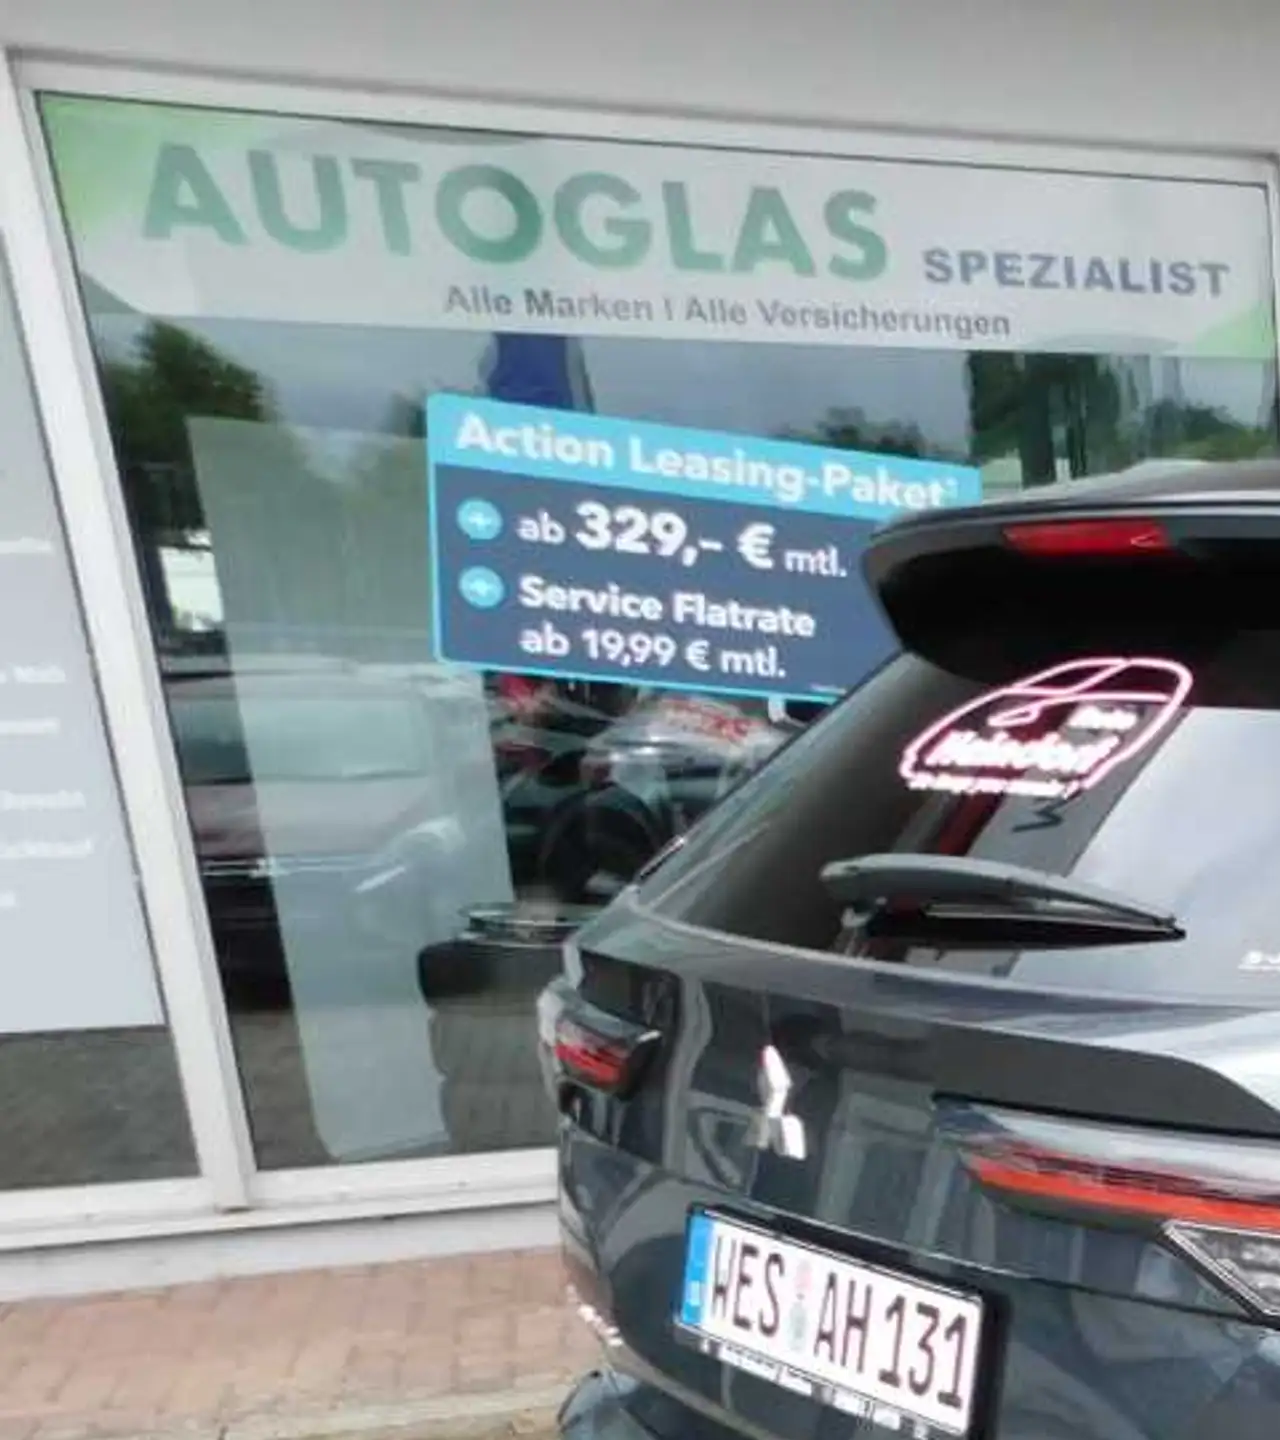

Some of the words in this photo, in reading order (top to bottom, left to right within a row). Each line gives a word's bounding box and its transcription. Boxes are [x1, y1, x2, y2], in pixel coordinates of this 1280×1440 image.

[141, 142, 888, 281] AUTOGLAS
[923, 249, 1231, 297] SPEZIALIST
[444, 285, 513, 318] Alle
[524, 289, 654, 323] Marken
[684, 297, 748, 327] Alle
[760, 299, 1011, 341] Versicherungen
[455, 410, 615, 469] Action
[516, 511, 566, 546] ab
[575, 500, 724, 567] 329,-
[737, 523, 776, 570] €
[783, 545, 848, 579] mtl.
[518, 575, 663, 622] Service
[672, 593, 818, 638] Flatrate
[519, 624, 570, 657] ab
[581, 628, 677, 670] 19,99
[684, 639, 711, 672] €
[720, 645, 787, 679] mtl.
[710, 1234, 785, 1338] WES
